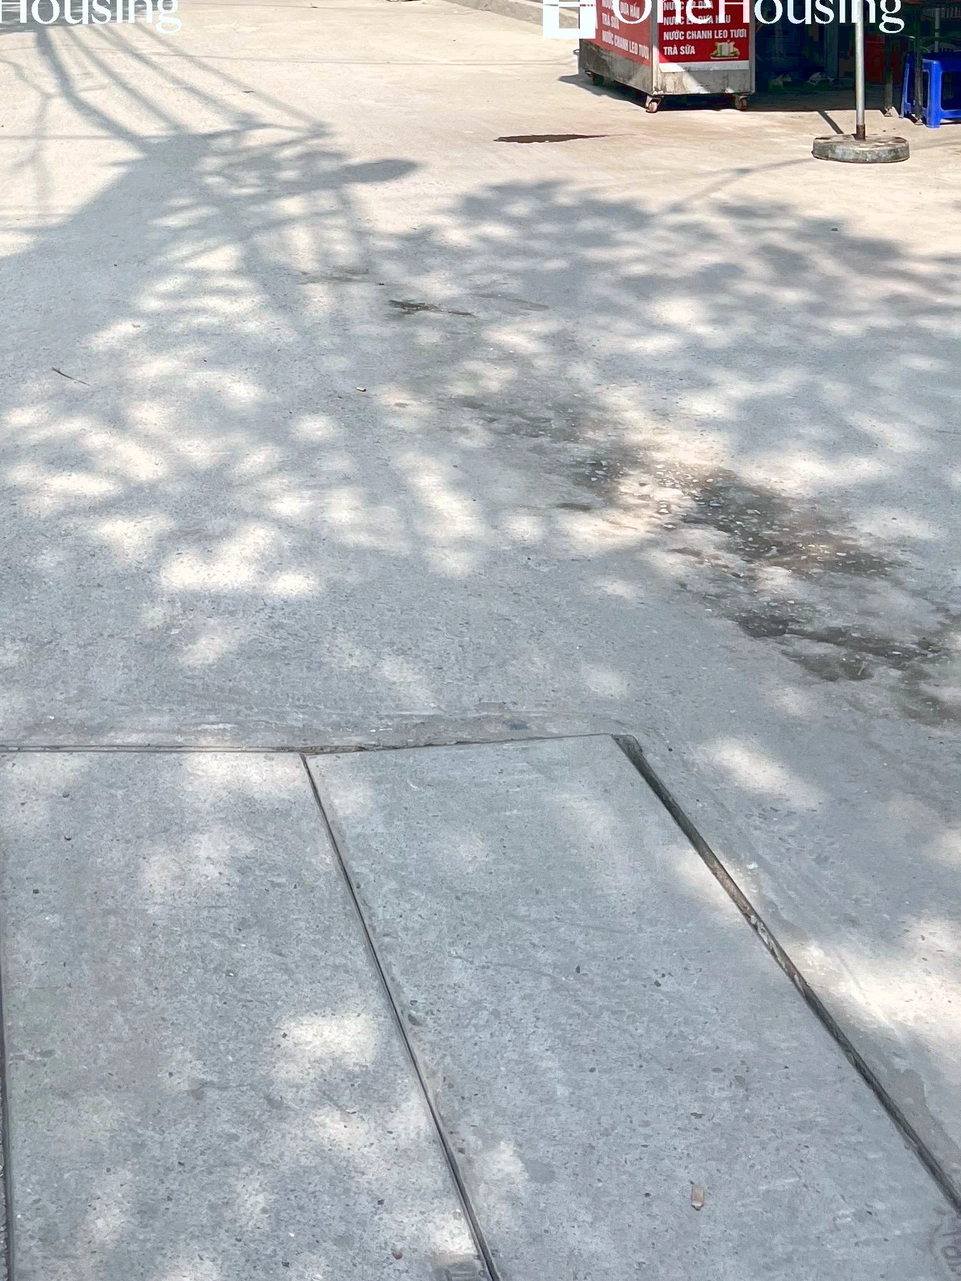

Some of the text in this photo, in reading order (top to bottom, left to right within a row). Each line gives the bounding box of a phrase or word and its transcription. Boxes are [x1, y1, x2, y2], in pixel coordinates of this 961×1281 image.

[663, 29, 684, 41] NƯỚC
[686, 30, 712, 40] CHANH
[714, 29, 728, 39] LEO
[663, 43, 696, 56] TRÀ SỮA
